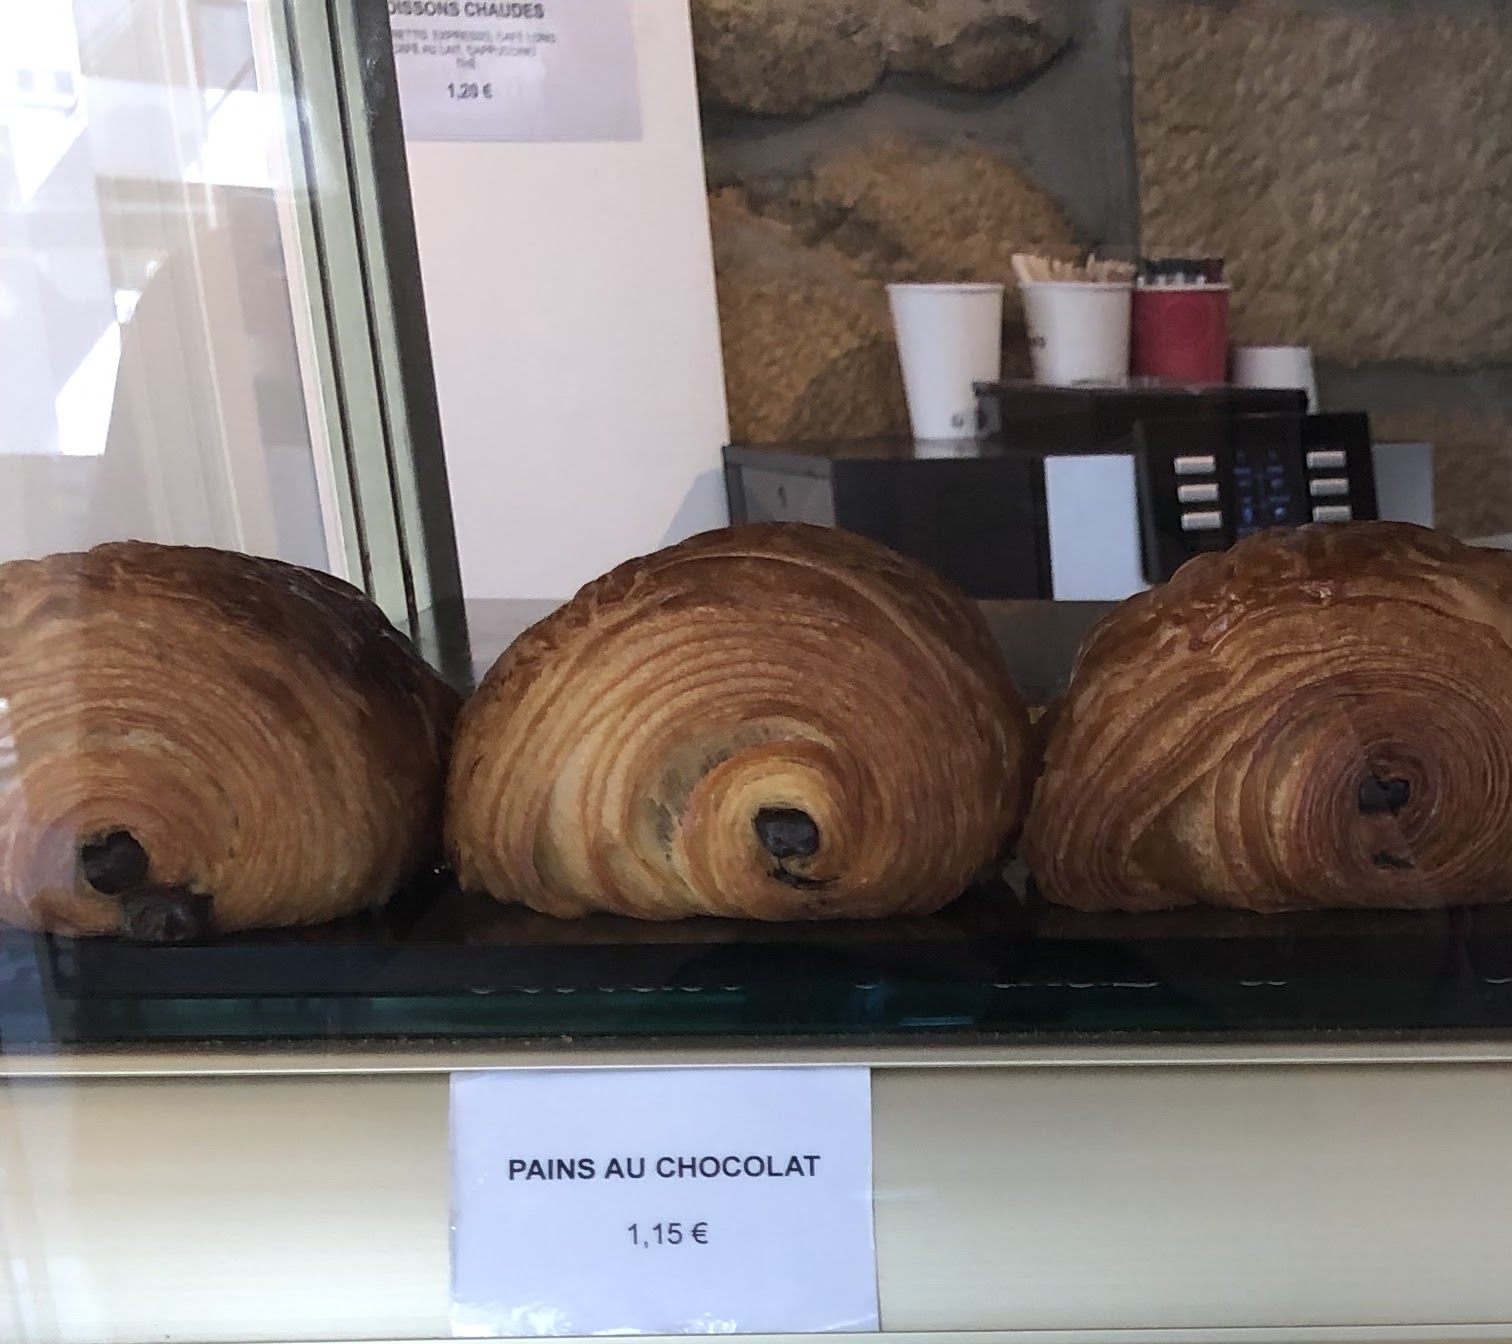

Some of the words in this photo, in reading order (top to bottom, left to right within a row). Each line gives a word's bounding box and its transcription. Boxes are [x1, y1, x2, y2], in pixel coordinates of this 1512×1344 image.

[388, 1, 460, 17] OISSONS
[464, 2, 545, 19] CHAUDES
[508, 1157, 596, 1181] PAINS
[603, 1157, 646, 1180] AU
[655, 1154, 821, 1179] CHOCOLAT
[627, 1222, 683, 1249] 1,15
[690, 1221, 709, 1245] €
